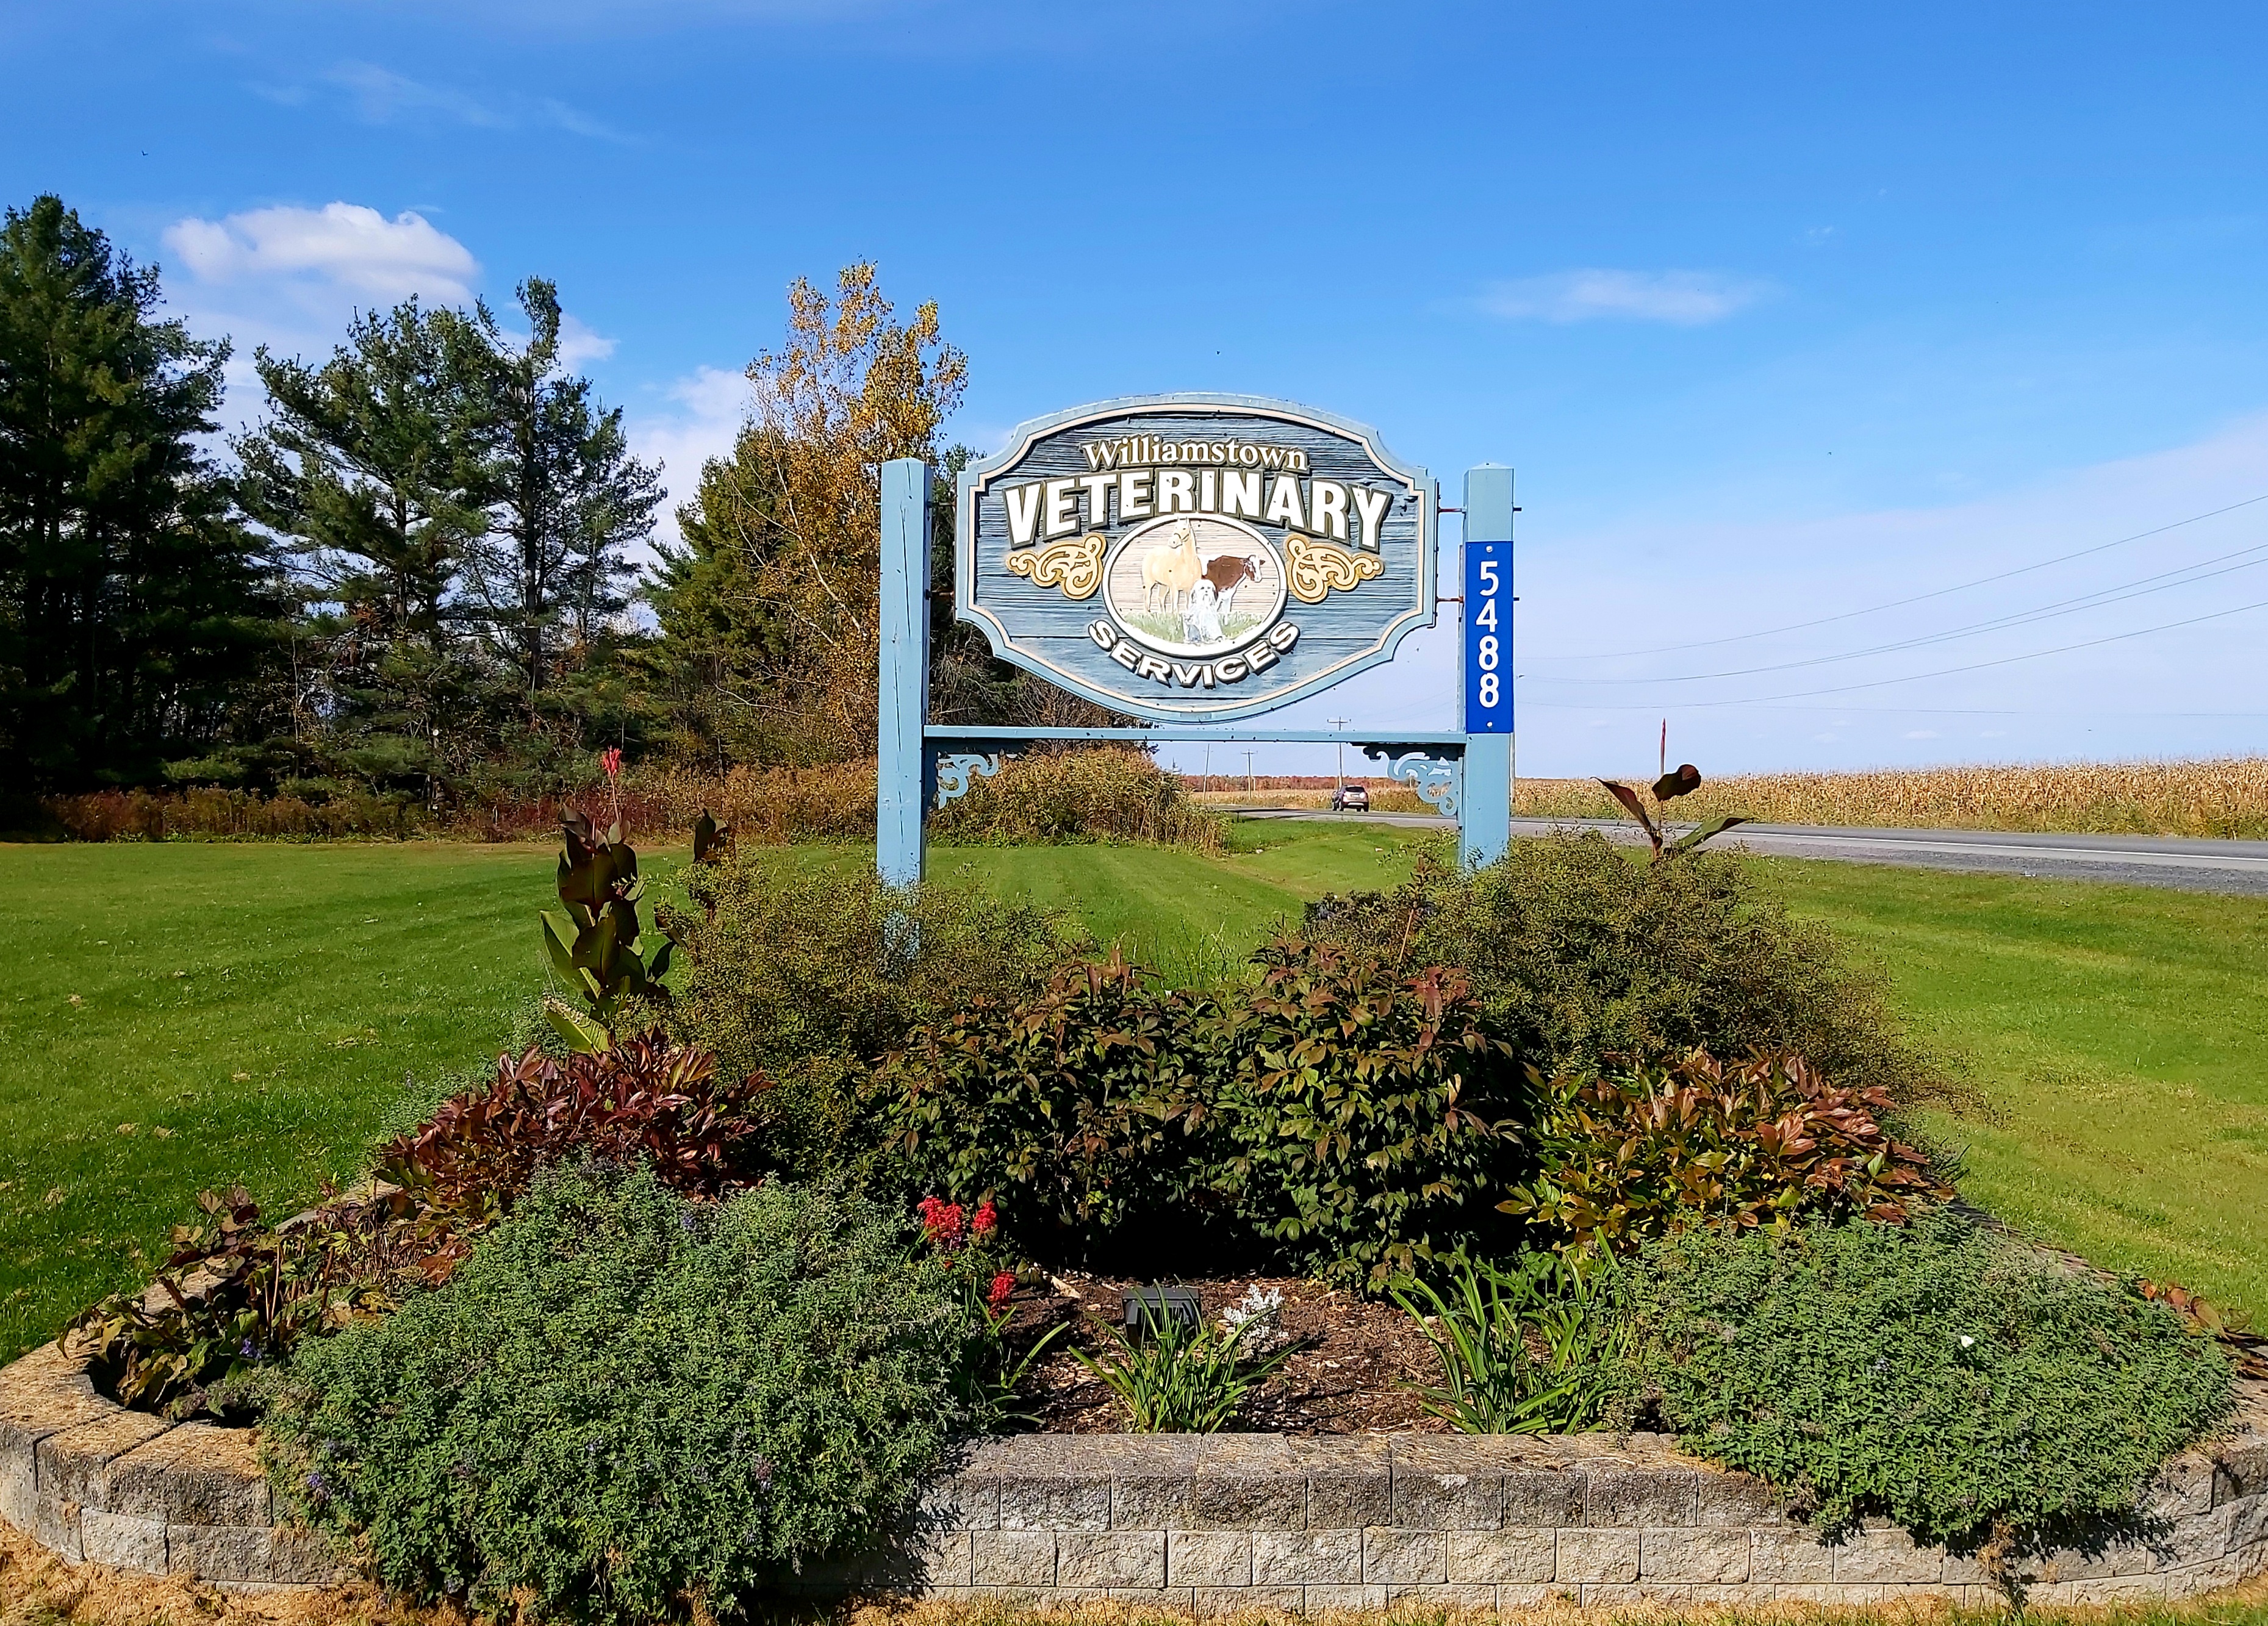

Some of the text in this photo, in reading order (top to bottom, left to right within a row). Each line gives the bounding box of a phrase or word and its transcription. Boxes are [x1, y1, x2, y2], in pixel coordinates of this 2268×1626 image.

[1082, 435, 1308, 472] Williamstown
[1006, 469, 1391, 550] VETERINARY
[1089, 620, 1300, 687] SERVICES
[1476, 561, 1499, 709] 5488
